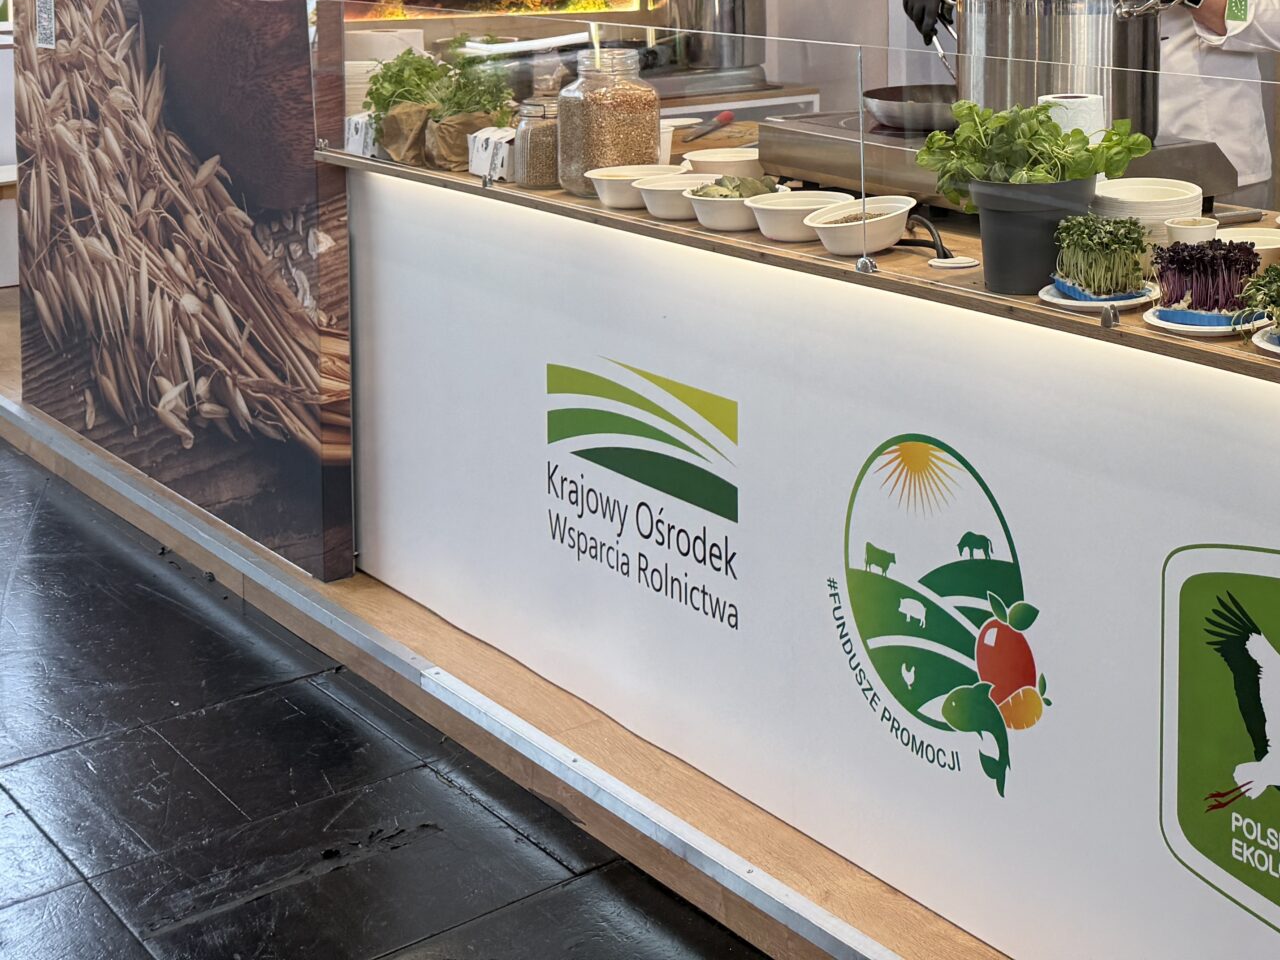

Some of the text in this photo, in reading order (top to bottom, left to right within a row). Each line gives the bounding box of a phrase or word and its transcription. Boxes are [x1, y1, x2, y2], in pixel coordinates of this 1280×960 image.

[547, 460, 738, 580] Krajowy Ośrodek
[548, 508, 739, 630] Wsparcia Rolnictwa
[826, 576, 961, 772] #FUNDUSZE PROMOCJI
